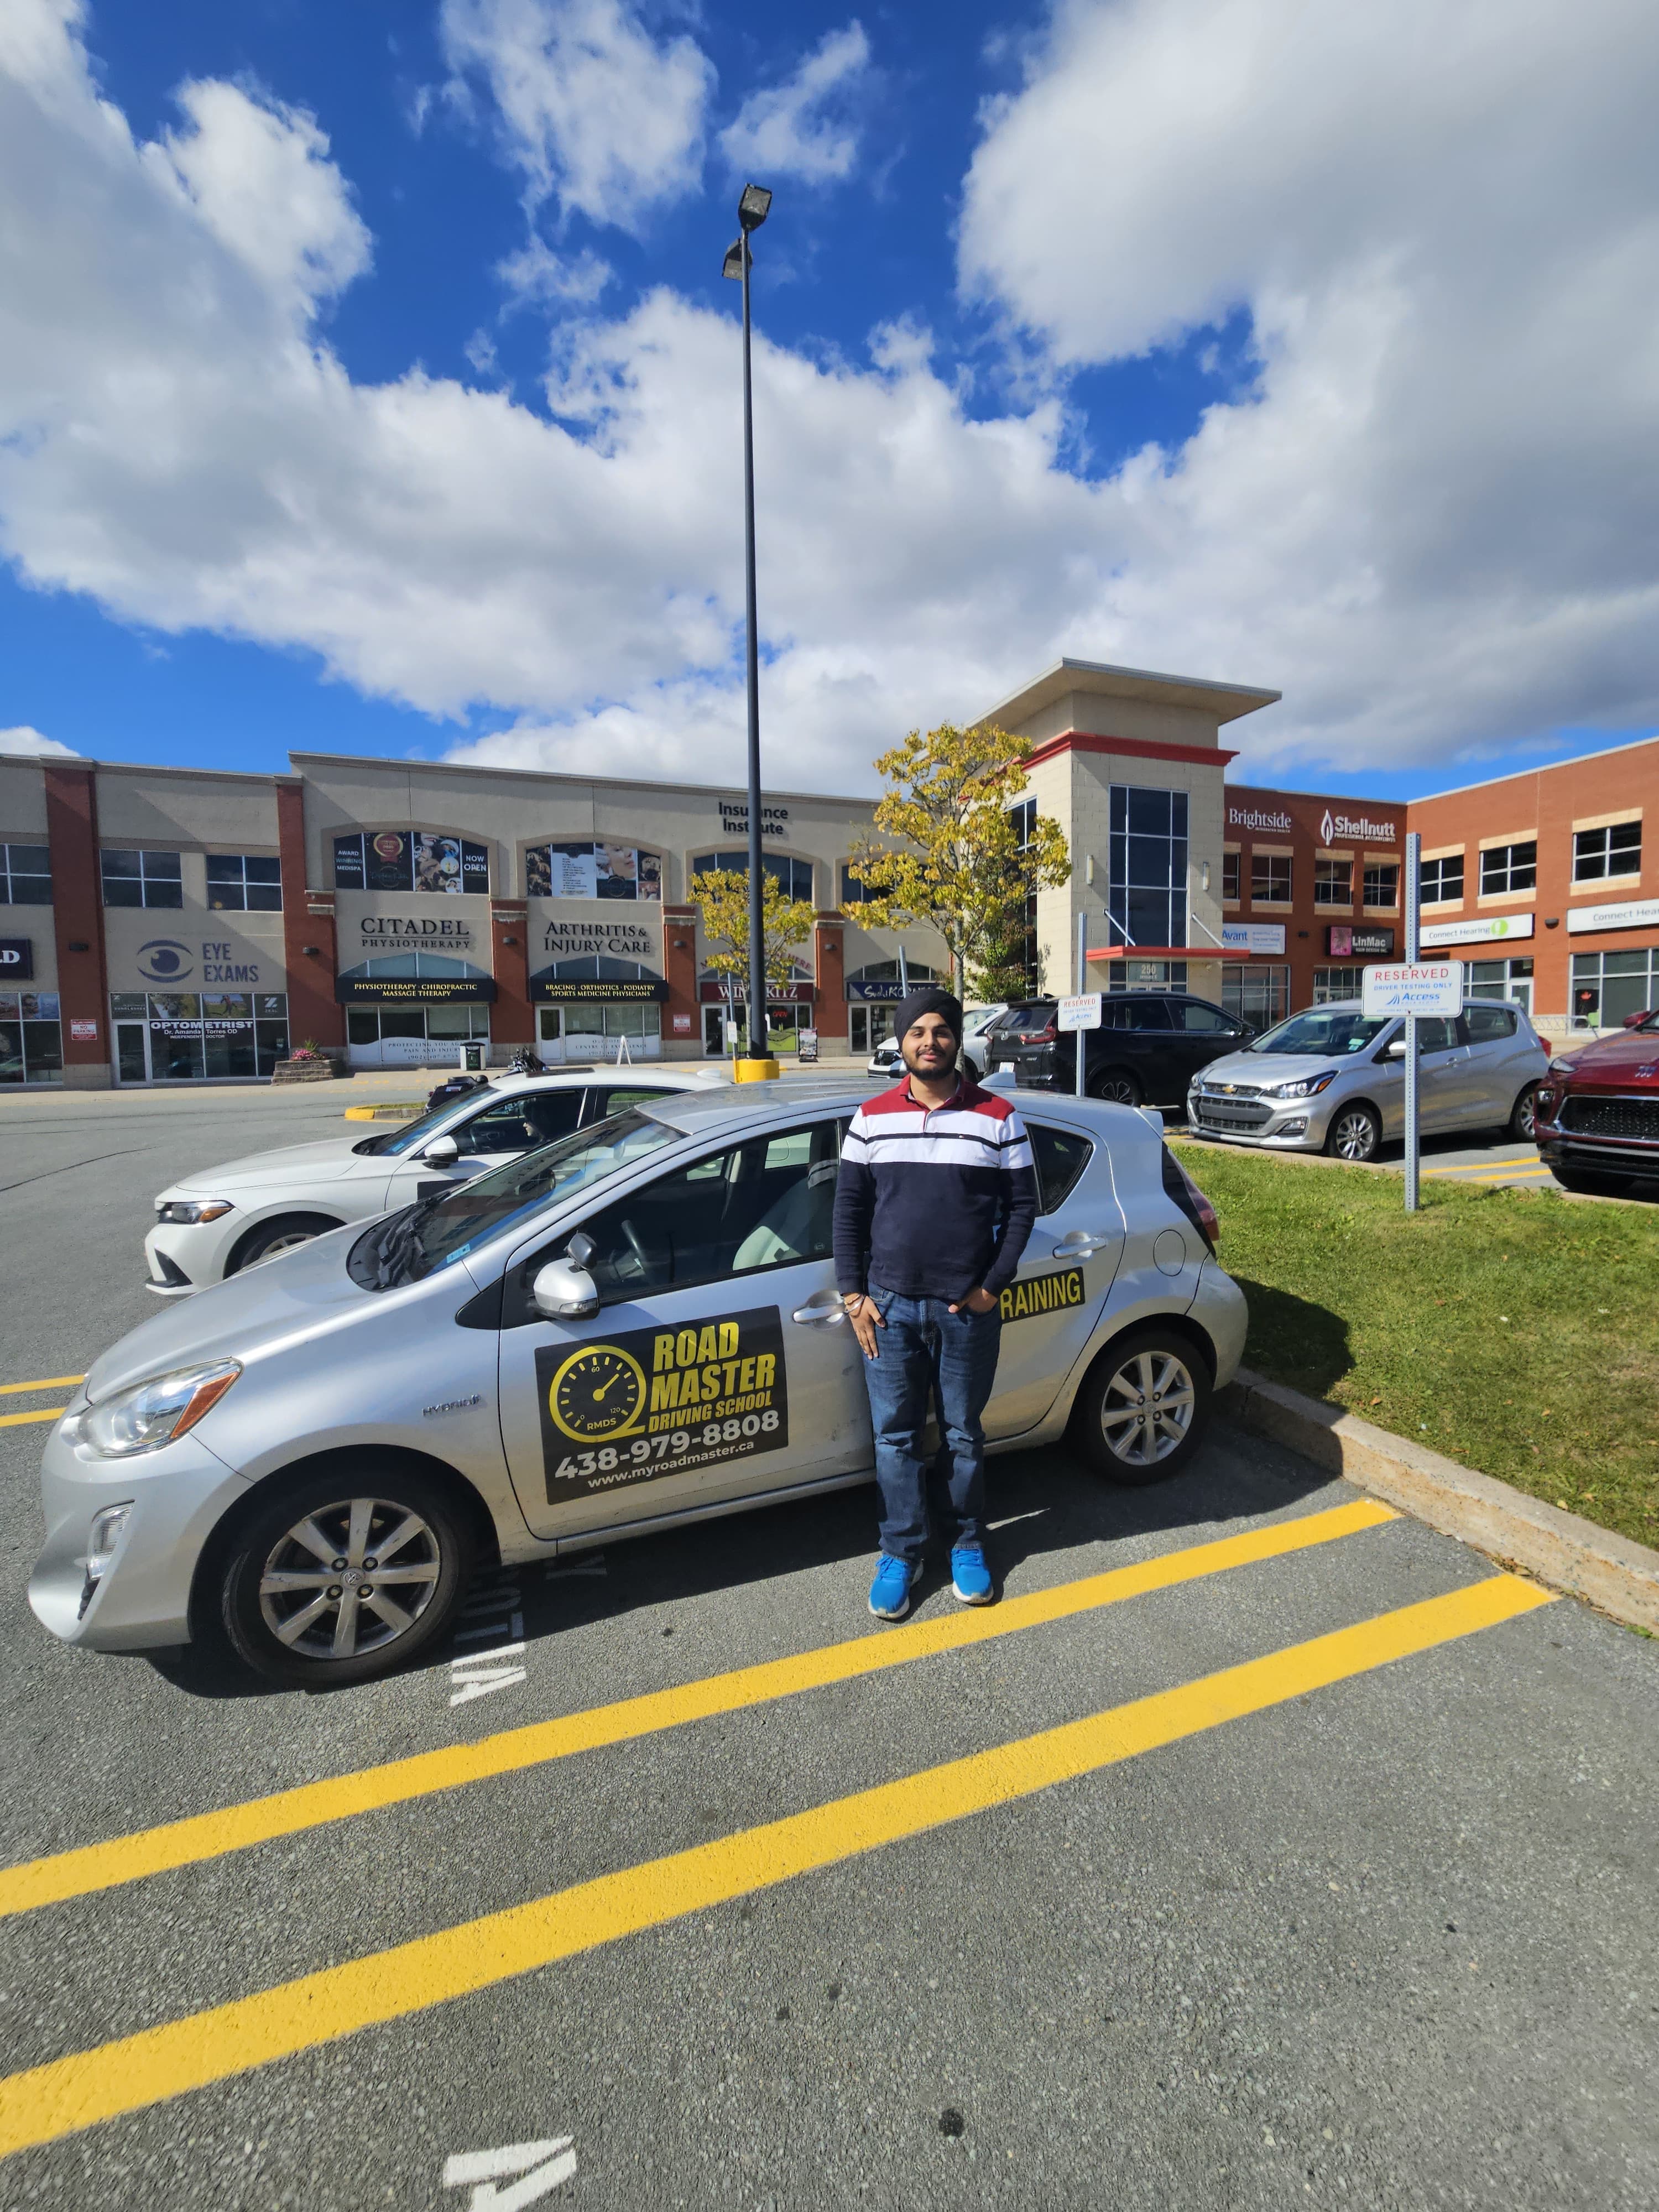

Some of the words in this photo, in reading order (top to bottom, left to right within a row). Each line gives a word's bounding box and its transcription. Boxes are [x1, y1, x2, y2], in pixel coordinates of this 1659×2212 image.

[719, 802, 789, 820] Insunce
[1229, 808, 1292, 830] Brightside
[723, 818, 784, 834] Instute
[1335, 816, 1395, 837] Shellnutt
[1593, 910, 1632, 921] Connect
[361, 918, 469, 935] CITADEL
[546, 921, 635, 937] ARTHRITIS
[638, 927, 646, 937] &
[1429, 931, 1457, 939] Connect
[1460, 926, 1490, 936] Hearing
[1222, 929, 1248, 941] Avant
[1352, 936, 1386, 947] LinMac
[202, 942, 231, 960] EYE
[362, 940, 470, 948] PHYSIOTHERAPY
[544, 938, 603, 954] INJURY
[608, 939, 650, 953] CARE
[0, 950, 20, 963] D
[204, 964, 259, 982] EXAMS
[1141, 964, 1156, 974] 250
[1375, 968, 1449, 981] RESERVED
[766, 987, 798, 998] KITZ
[1064, 998, 1095, 1008] RESERVED
[1000, 1272, 1081, 1320] RAINING
[653, 1322, 739, 1372] ROAD
[650, 1354, 776, 1412] MASTER
[648, 1404, 712, 1433] DRIVING
[715, 1390, 773, 1417] SCHOOL
[587, 1417, 617, 1431] RMDS
[555, 1410, 779, 1479] 438-979-8808
[588, 1440, 754, 1488] www.myroadmaster.ca
